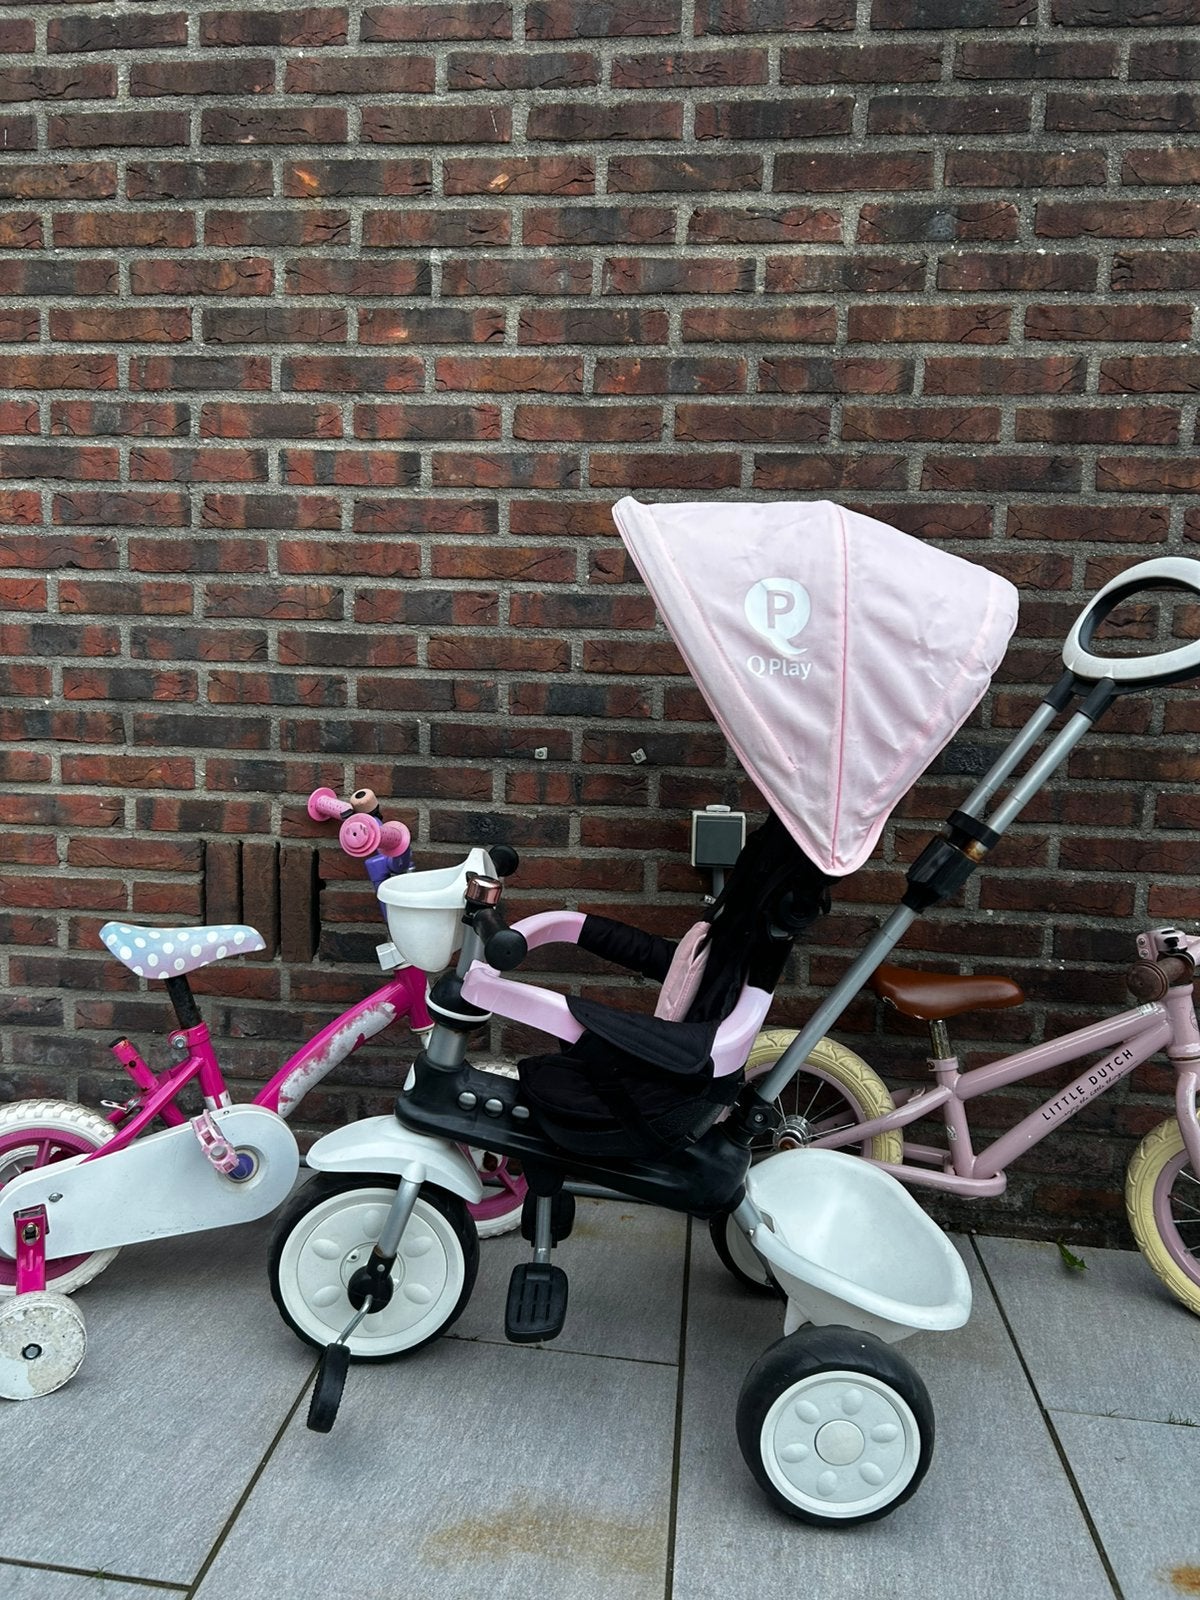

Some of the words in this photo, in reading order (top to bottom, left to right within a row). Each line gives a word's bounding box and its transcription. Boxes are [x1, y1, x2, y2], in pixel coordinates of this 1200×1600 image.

[769, 658, 811, 680] Play
[1042, 1085, 1085, 1121] LITTLE
[1088, 1049, 1133, 1085] DUTCH
